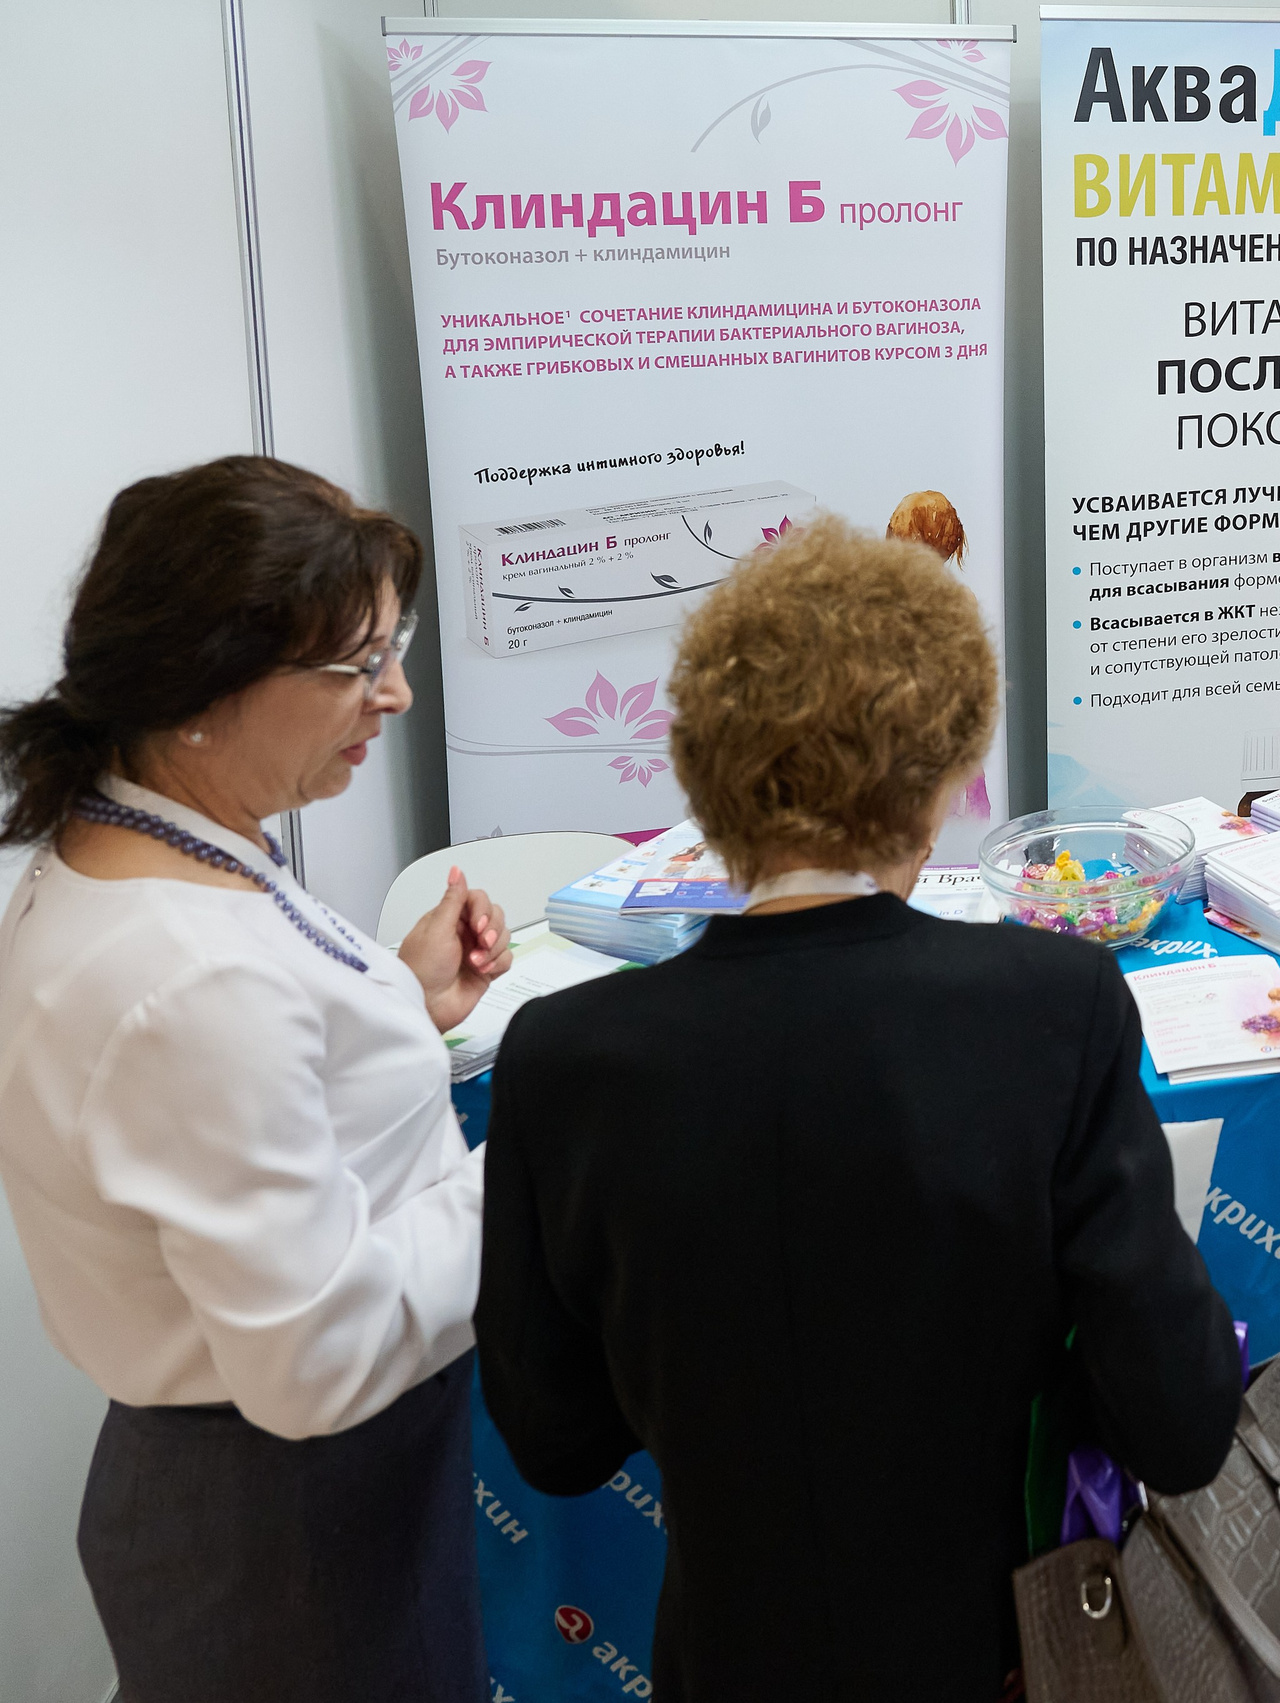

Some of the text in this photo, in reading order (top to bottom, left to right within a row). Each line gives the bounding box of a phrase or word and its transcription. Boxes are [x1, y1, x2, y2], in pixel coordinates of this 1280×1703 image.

[430, 180, 964, 238] Клиндацин Б пролонг
[436, 245, 731, 271] Бутоконазол + клиндамицин
[1076, 237, 1117, 267] ПО
[579, 306, 683, 324] СОЧЕТАНИЕ
[687, 302, 833, 320] КЛИНДАМИЦИНА
[837, 302, 849, 315] И
[852, 297, 982, 315] БУТОКОНАЗОЛА
[442, 320, 965, 355] ДЛЯ ЭМПИРИЧЕСКОЙ ТЕРАПИИ БАКТЕРИАЛЬНОГО ВАГИНОЗА,
[444, 343, 988, 379] А ТАКЖЕ ГРИБКОВЫХ И СМЕШАННЫХ ВАГИНИТОВ КУРСОМ 3 ДНЯ
[474, 440, 746, 486] Поддержка интимного здоровья!
[1072, 488, 1227, 514] УСВАИВАЕТСЯ
[1073, 523, 1120, 541] ЧЕМ
[1126, 516, 1208, 543] ДРУГИЕ
[501, 531, 672, 567] Клиндацин Б пролонг
[502, 570, 527, 582] крем
[528, 559, 587, 577] вагинальный
[588, 556, 595, 567] 2
[596, 554, 607, 565] %
[616, 552, 623, 563] 2
[624, 550, 635, 561] %
[1090, 560, 1175, 578] Поступает
[1179, 559, 1187, 570] в
[1191, 553, 1268, 571] организм
[1089, 586, 1122, 602] для
[1126, 578, 1230, 597] всасывания
[507, 618, 555, 635] бутоконазол
[563, 609, 613, 625] клиндамицин
[1090, 611, 1200, 631] Всасывается
[1204, 611, 1214, 621] в
[1217, 604, 1256, 620] ЖКТ
[508, 638, 528, 650] 20 г
[1090, 642, 1109, 654] от
[1112, 635, 1177, 652] степени
[1181, 633, 1207, 645] его
[1090, 665, 1101, 676] и
[1104, 649, 1229, 676] сопутствующей
[1090, 689, 1169, 709] Подходит
[1172, 687, 1200, 702] для
[1205, 680, 1241, 697] всей
